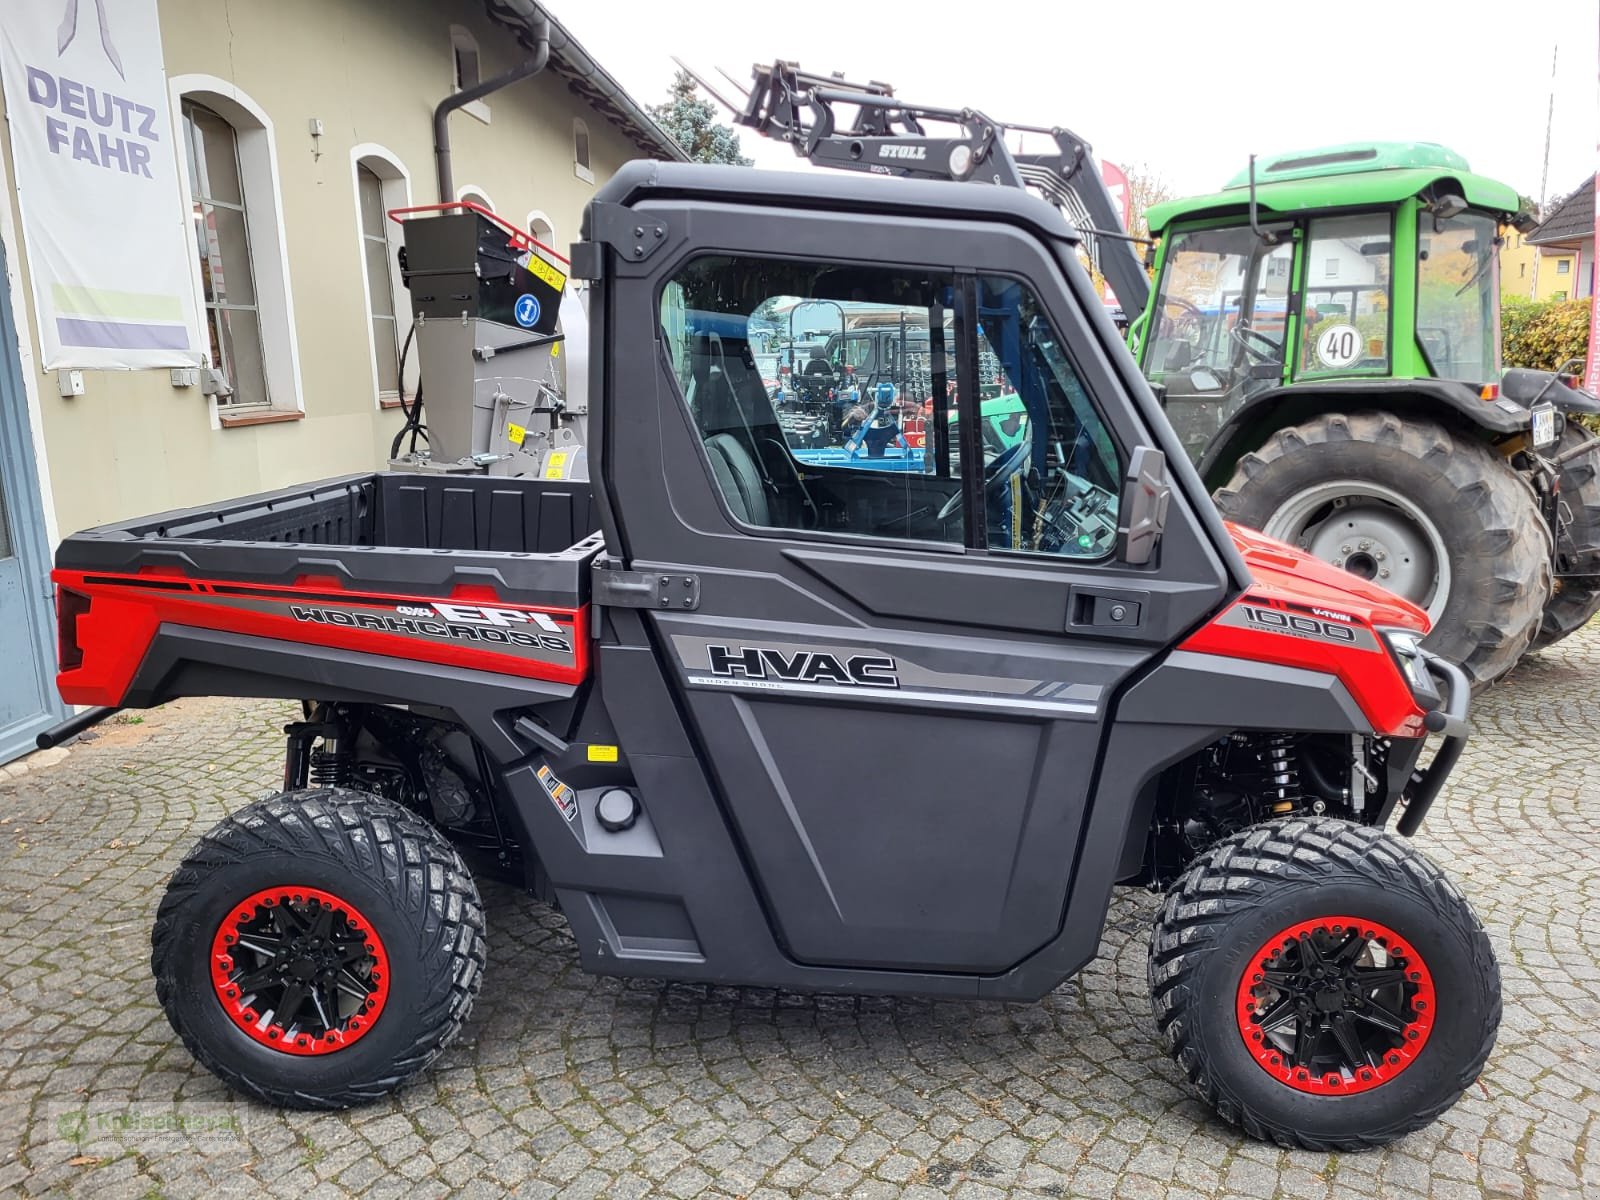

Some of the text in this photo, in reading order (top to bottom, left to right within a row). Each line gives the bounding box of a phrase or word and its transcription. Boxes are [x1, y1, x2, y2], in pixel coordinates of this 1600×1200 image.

[26, 64, 159, 142] DEUTZ
[46, 115, 153, 179] FAHR
[879, 144, 927, 160] STOLL
[1326, 332, 1353, 360] 40
[289, 605, 573, 653] WORKCROSS
[430, 603, 566, 633] EFI
[1241, 605, 1356, 642] 1000
[1311, 608, 1352, 622] V-TWIN
[706, 644, 900, 689] HVAC
